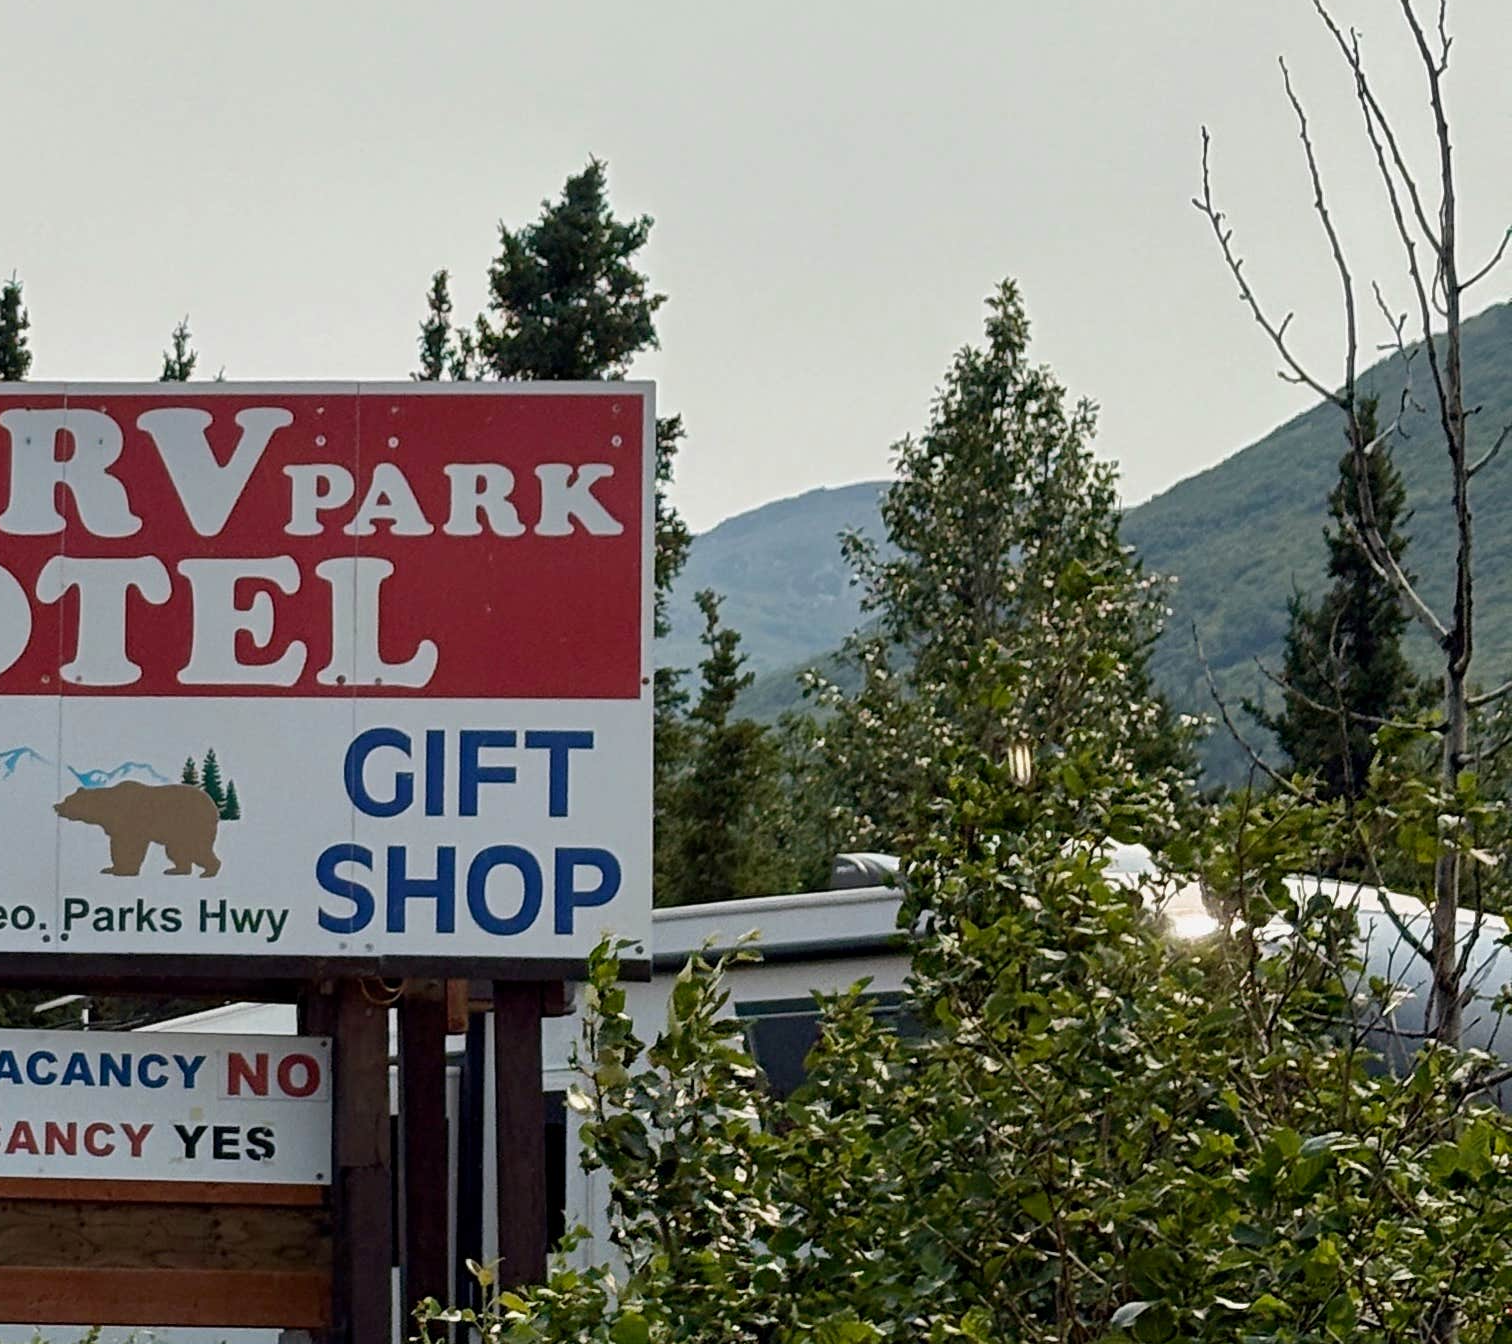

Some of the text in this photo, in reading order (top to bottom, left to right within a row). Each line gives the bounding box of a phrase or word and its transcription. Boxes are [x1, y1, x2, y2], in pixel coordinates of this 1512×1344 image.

[283, 463, 623, 536] PARK
[344, 728, 595, 817] GIFT
[316, 844, 621, 936] SHOP
[64, 898, 183, 933] Parks
[200, 900, 289, 943] Hwy
[227, 1052, 321, 1098] NO
[175, 1124, 276, 1161] YES
